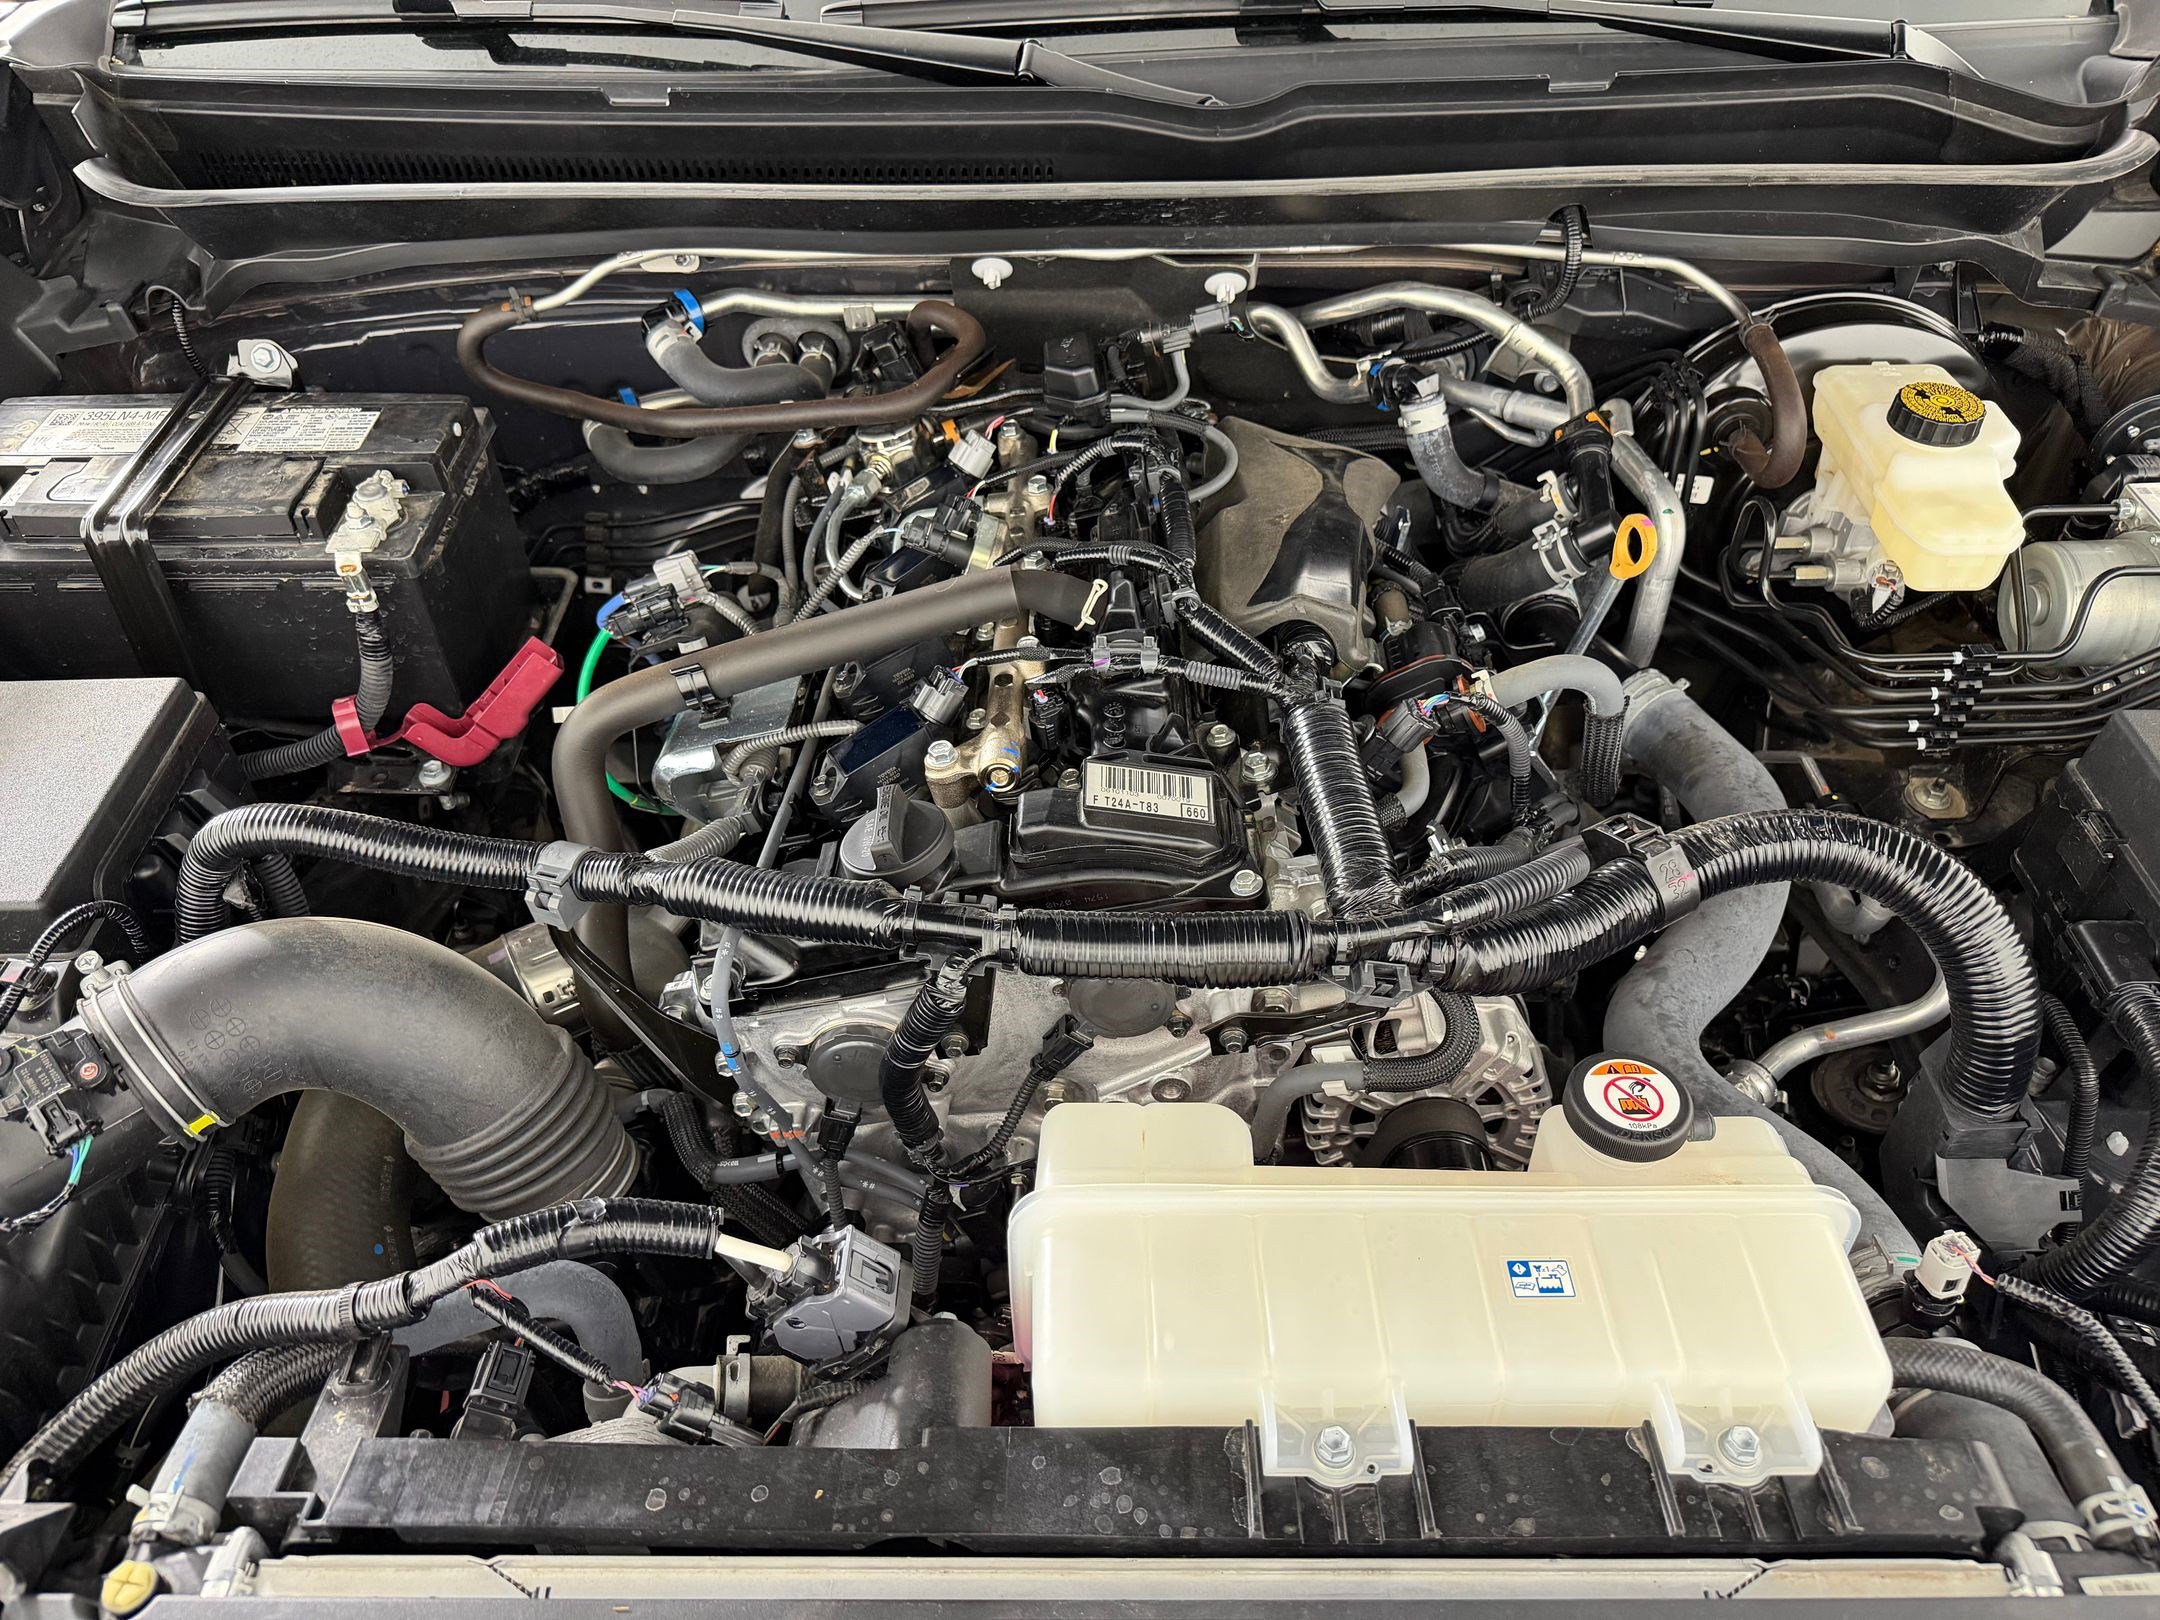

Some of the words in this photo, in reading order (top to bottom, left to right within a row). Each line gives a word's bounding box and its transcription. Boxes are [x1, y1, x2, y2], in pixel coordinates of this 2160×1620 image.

[82, 410, 168, 421] 395LN4-MF
[877, 766, 897, 779] TOYOTA
[1092, 795, 1098, 804] F
[1104, 796, 1159, 813] T24A-T83
[1186, 807, 1206, 819] 660
[1659, 858, 1681, 884] 28
[1667, 877, 1690, 904] 32
[1628, 1122, 1658, 1130] 108kPa
[1617, 1127, 1673, 1142] DENSO
